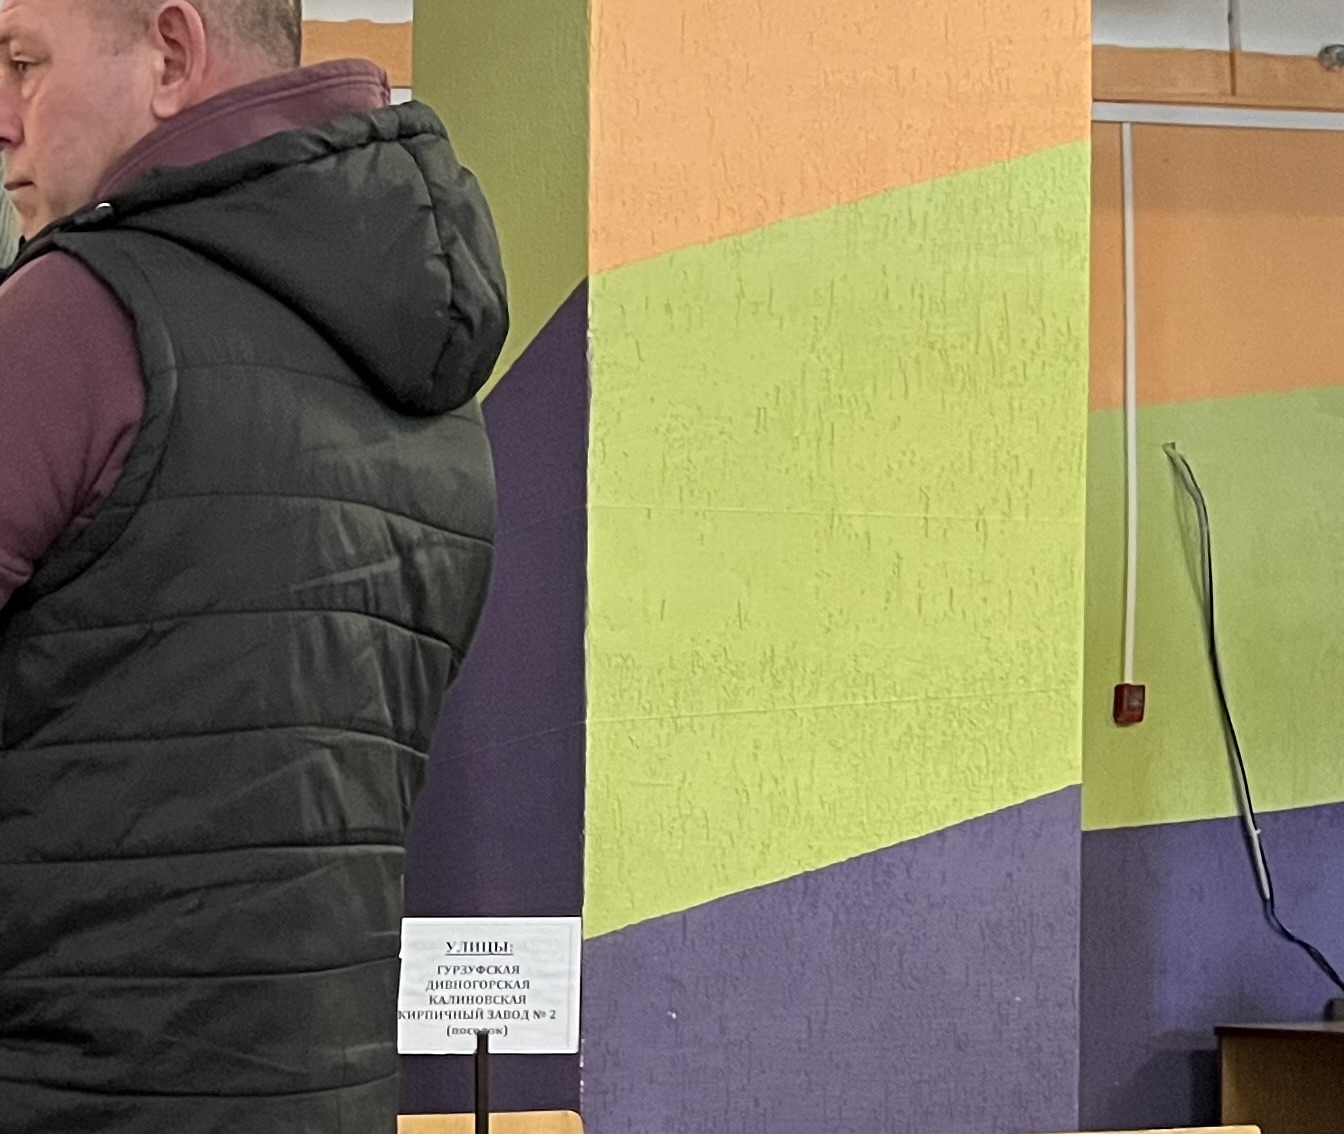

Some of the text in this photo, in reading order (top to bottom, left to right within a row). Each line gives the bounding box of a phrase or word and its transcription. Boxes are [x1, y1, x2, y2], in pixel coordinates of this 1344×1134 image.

[437, 965, 520, 975] ГУРЗУФСКАЯ
[425, 980, 530, 992] ДИВНОГОРСКАЯ
[429, 995, 526, 1005] КАЛИНОВСКАЯ
[398, 1008, 484, 1020] КИРПИЧНЫЙ
[487, 1010, 529, 1021] ЗАВОД
[549, 1010, 556, 1019] 2
